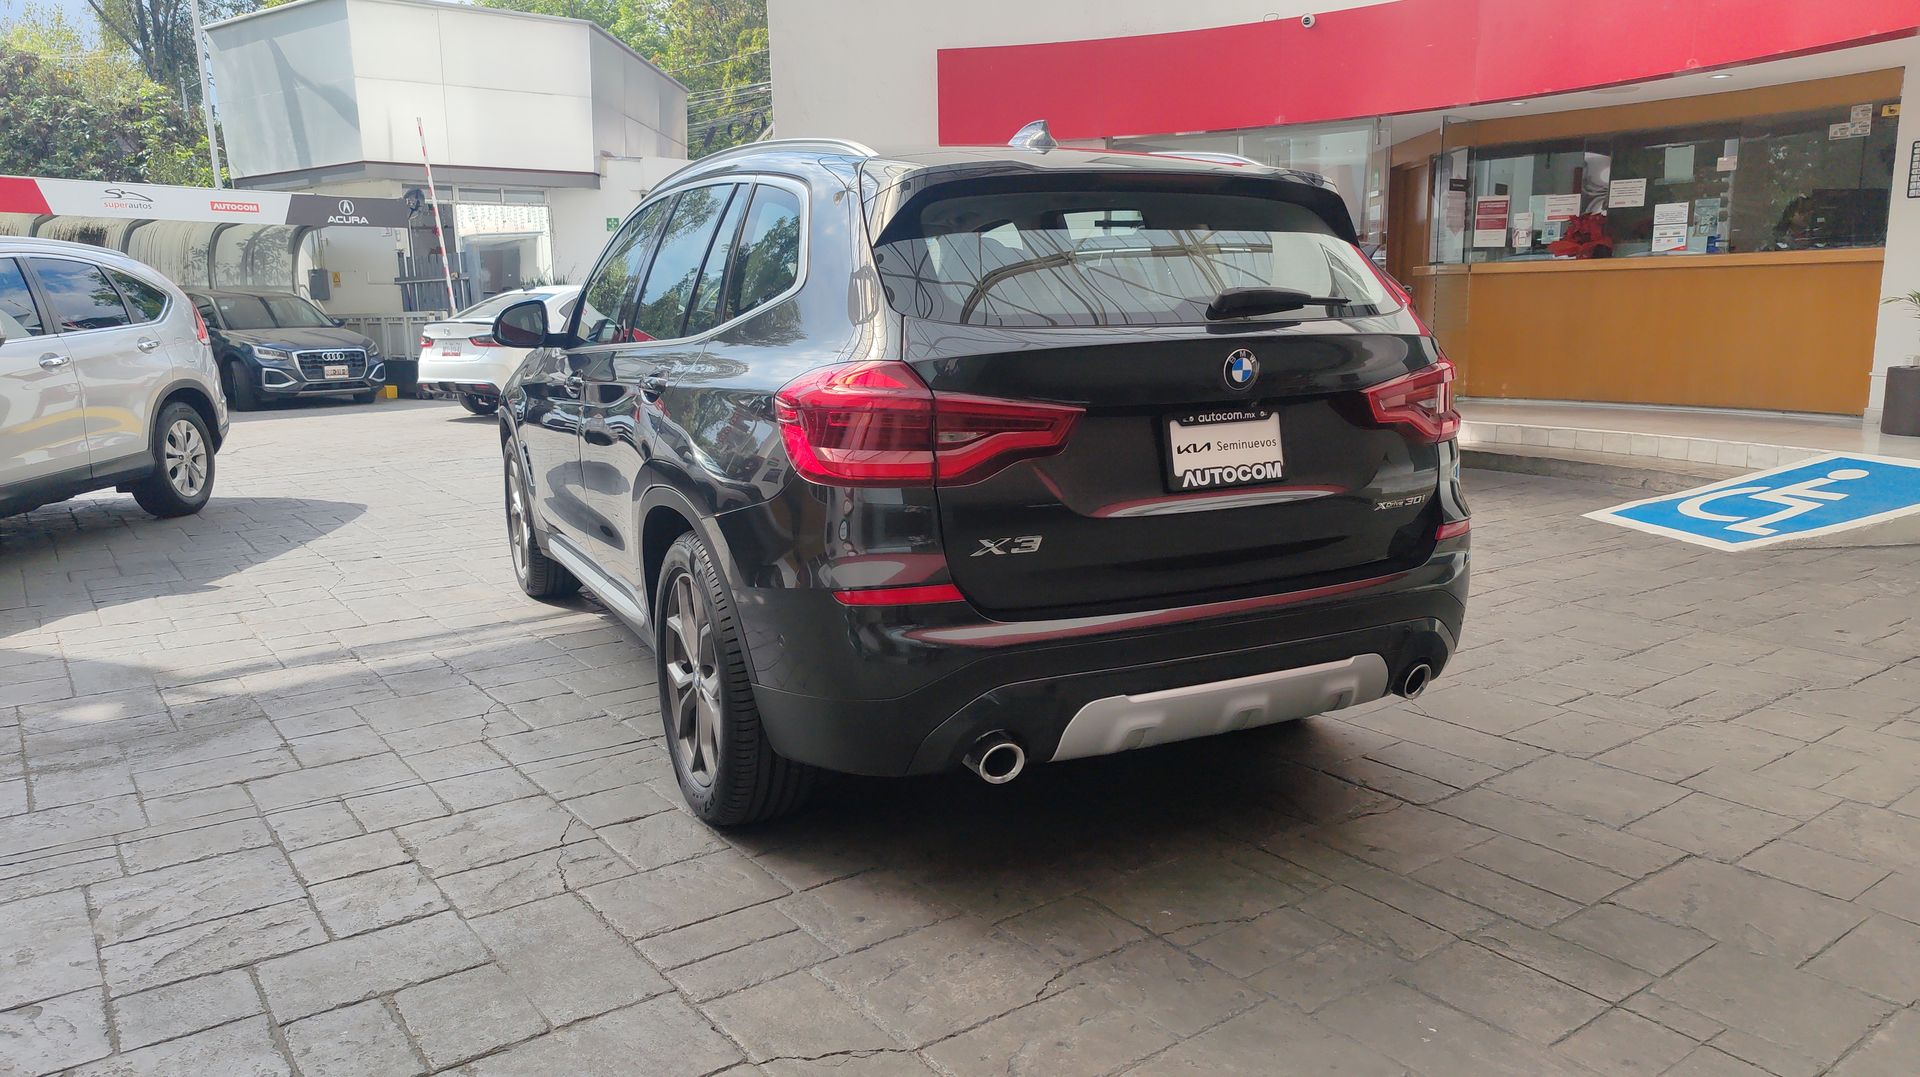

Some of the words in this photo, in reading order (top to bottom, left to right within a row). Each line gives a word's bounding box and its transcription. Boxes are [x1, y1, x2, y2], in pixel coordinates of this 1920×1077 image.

[104, 201, 152, 210] superautos
[213, 203, 258, 212] AUTOCOM
[327, 215, 369, 225] ACURA
[1198, 411, 1255, 422] autocom.mx
[1177, 442, 1211, 454] KIA
[1216, 439, 1276, 451] Seminuevos
[1182, 462, 1281, 487] AUTOCOM
[969, 536, 1043, 557] X3
